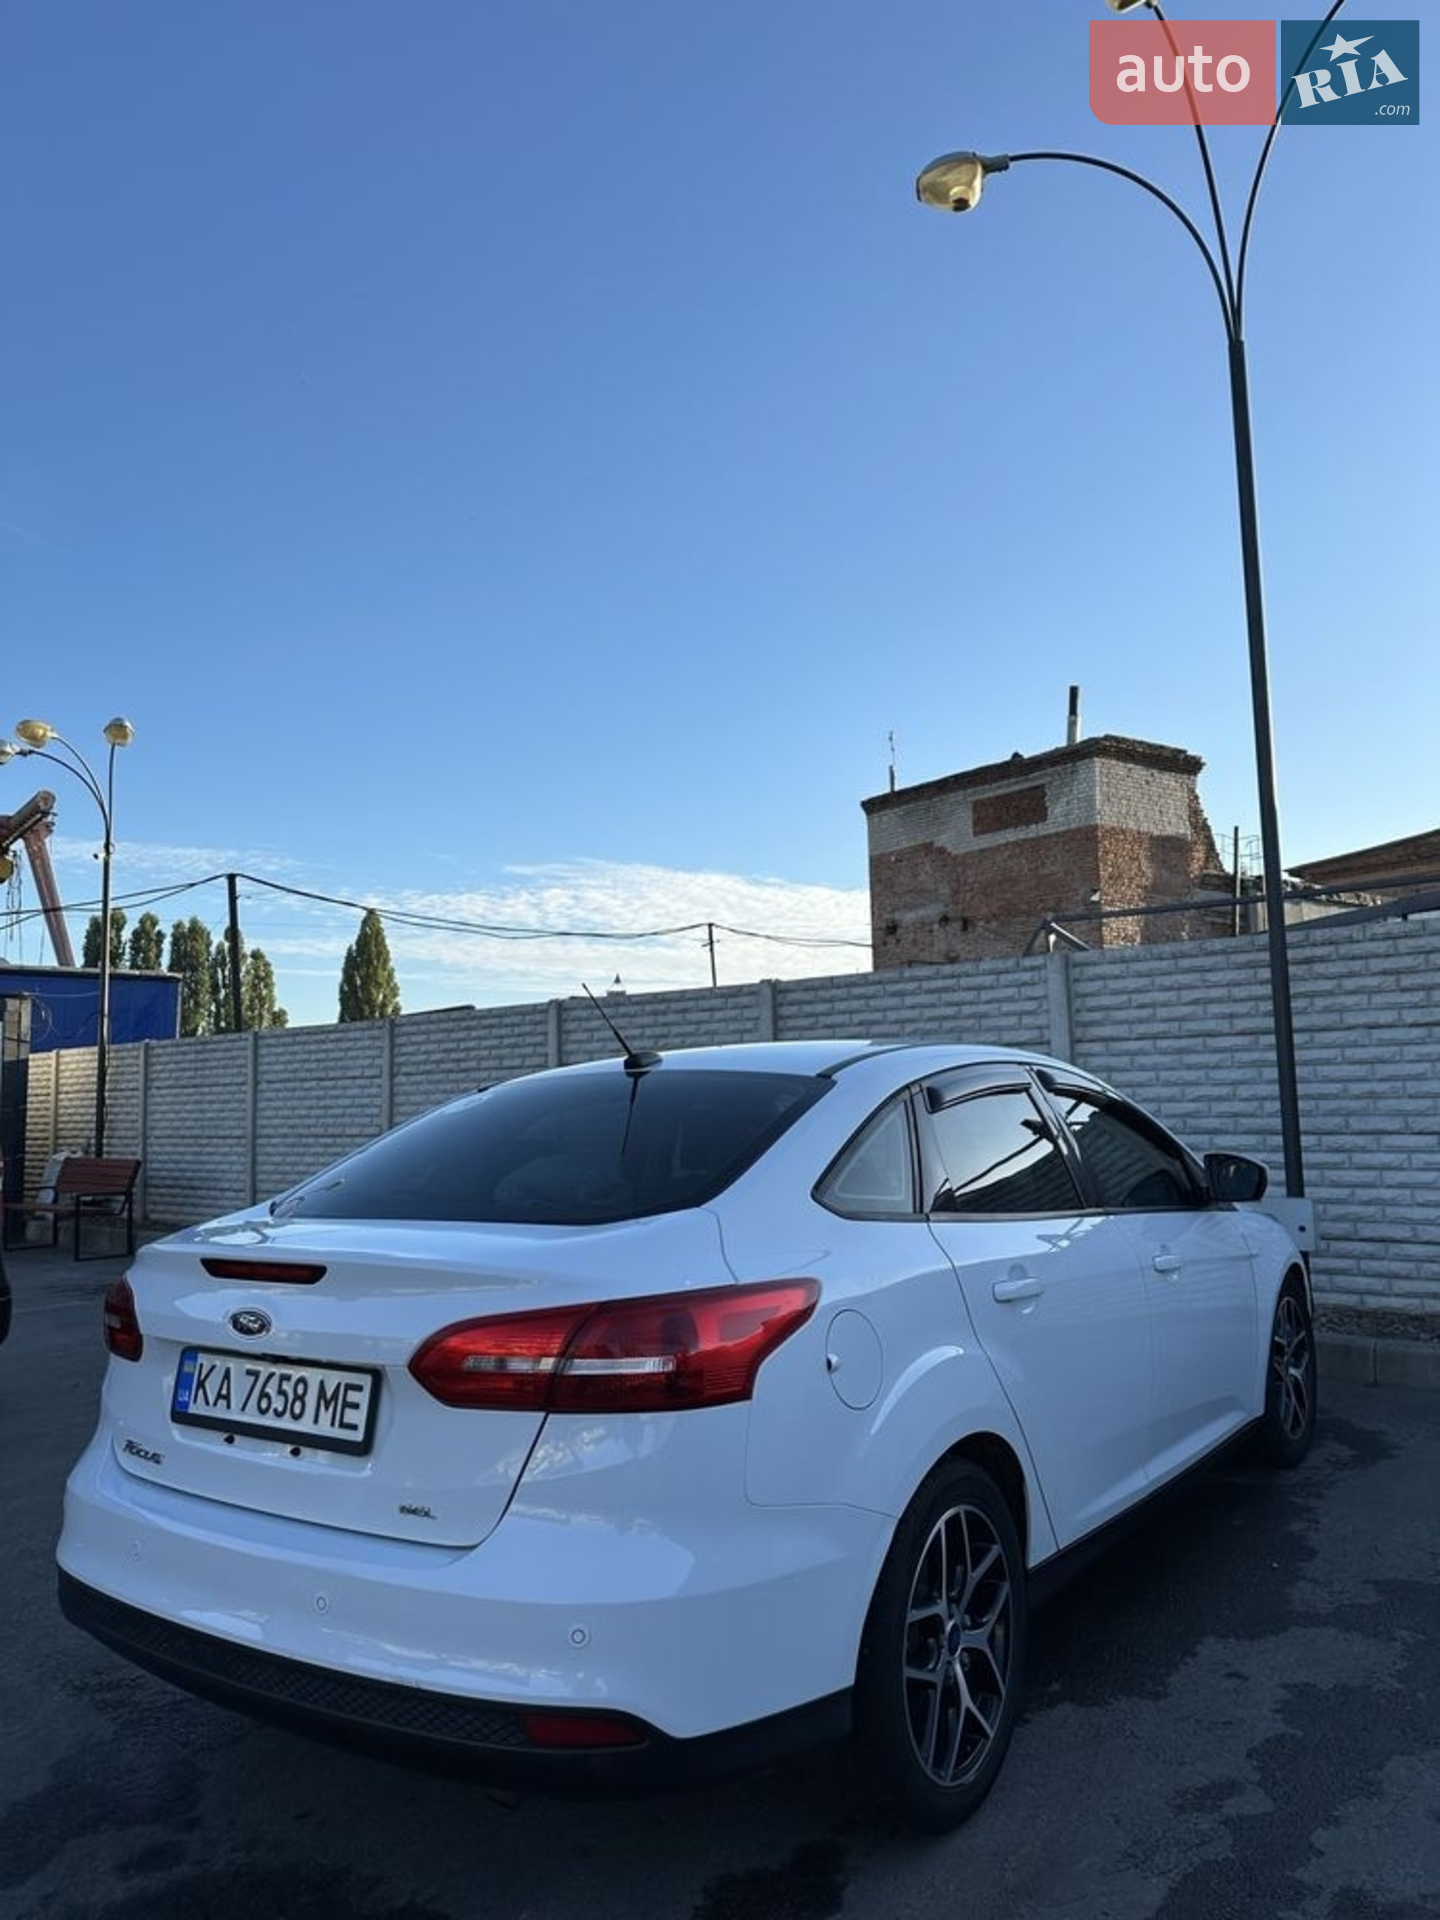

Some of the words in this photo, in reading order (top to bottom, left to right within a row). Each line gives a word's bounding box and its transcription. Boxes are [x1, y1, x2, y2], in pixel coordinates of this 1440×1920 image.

[193, 1362, 232, 1411] KA
[241, 1368, 309, 1421] 7658
[313, 1379, 364, 1431] ME
